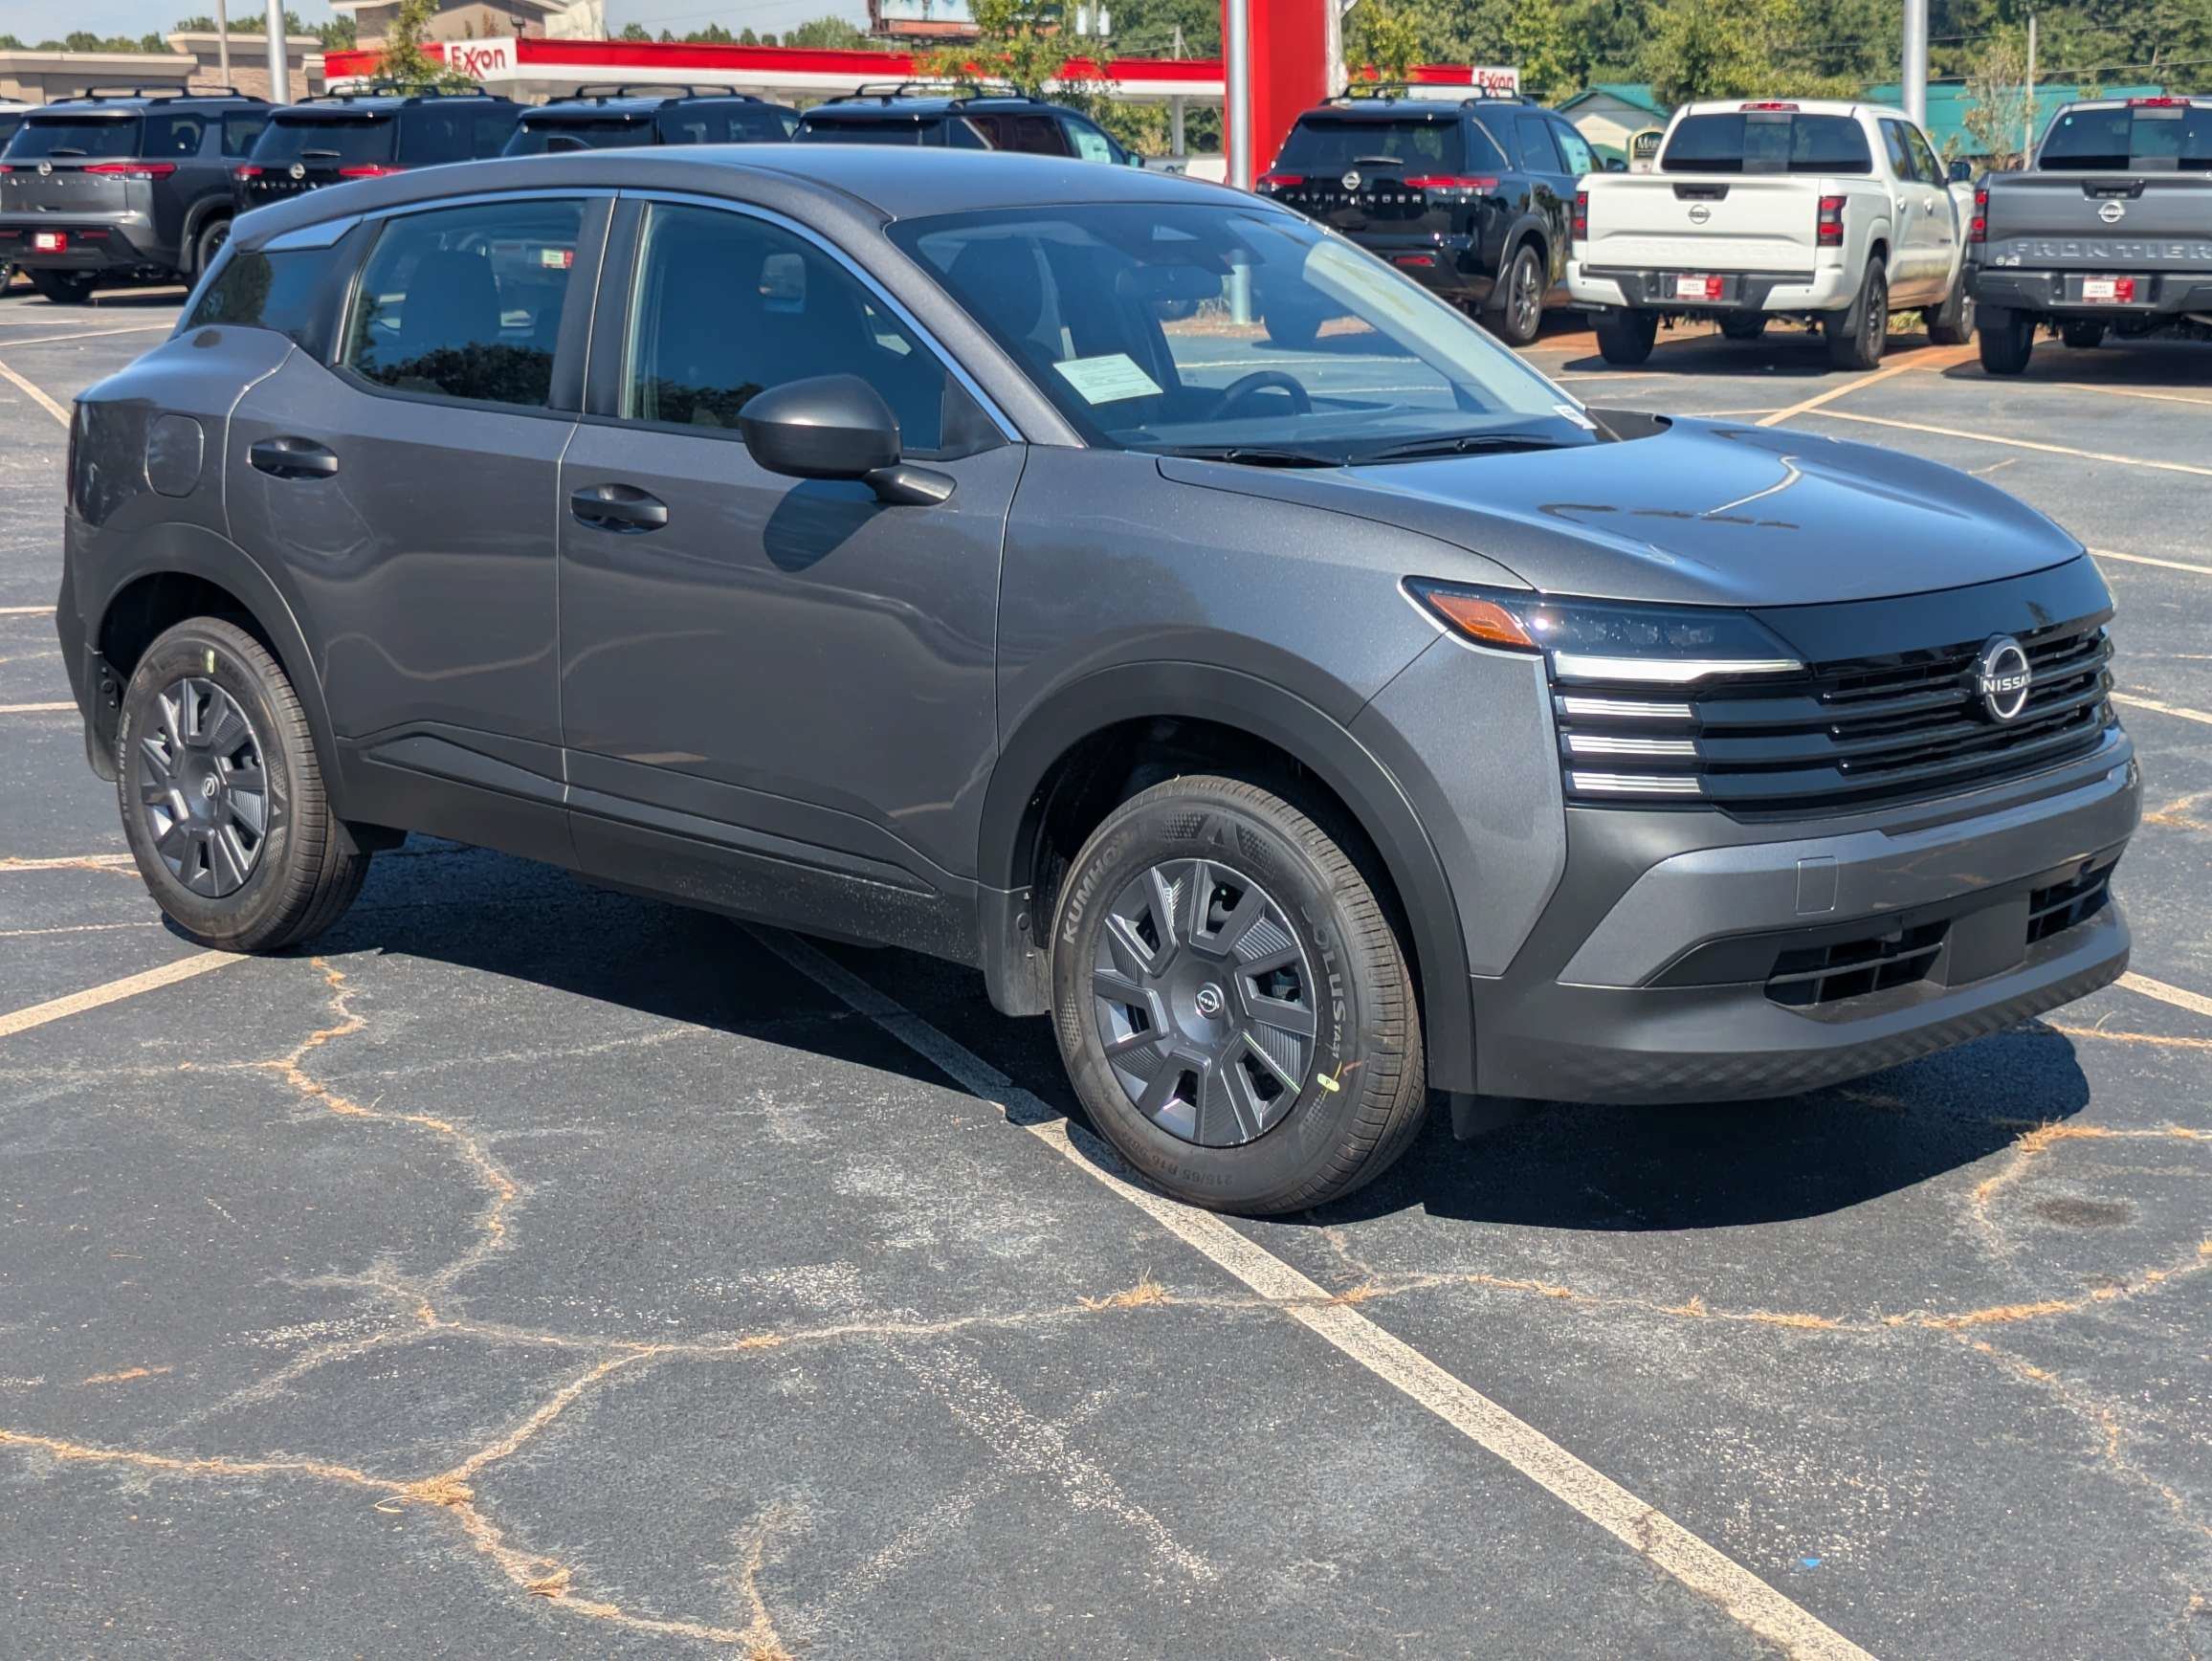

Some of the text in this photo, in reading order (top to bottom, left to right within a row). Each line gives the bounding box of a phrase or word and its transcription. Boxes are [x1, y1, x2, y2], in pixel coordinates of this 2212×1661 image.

[451, 46, 506, 80] Exxon
[1479, 71, 1514, 97] Exxon
[1286, 193, 1422, 205] PATHFINDER
[2010, 243, 2212, 259] FRONTIER
[1063, 845, 1118, 944] KUMHO
